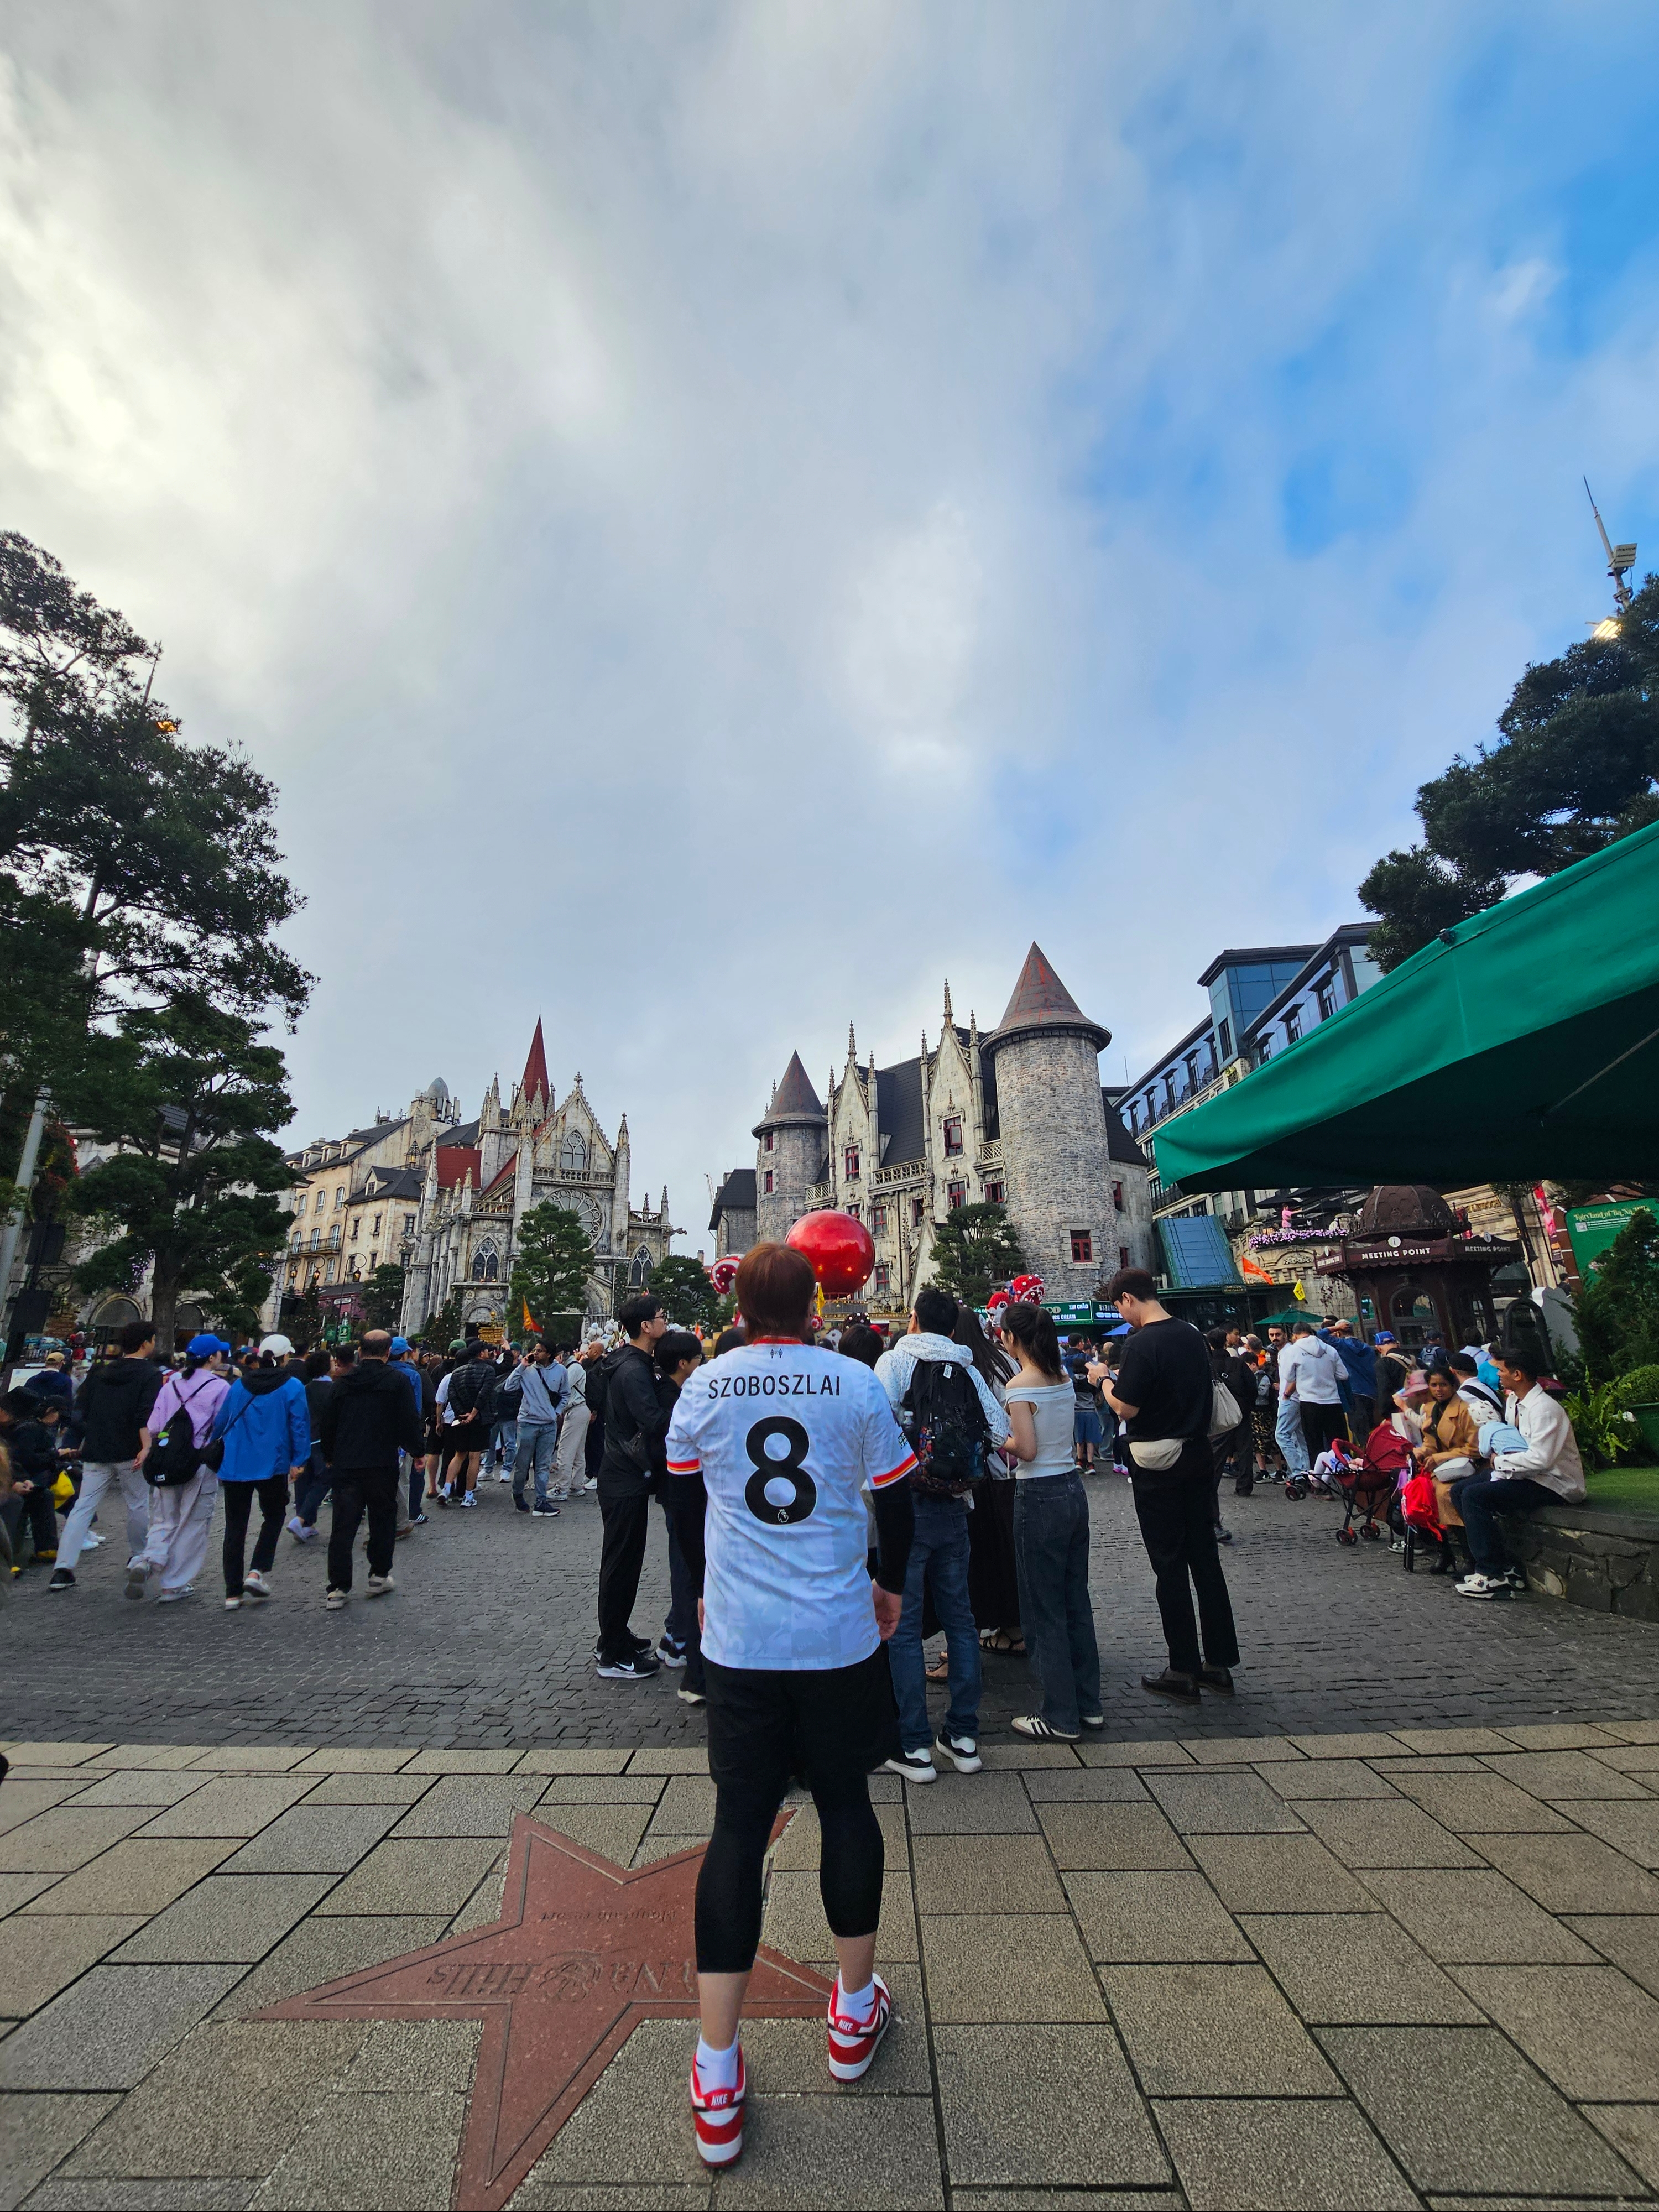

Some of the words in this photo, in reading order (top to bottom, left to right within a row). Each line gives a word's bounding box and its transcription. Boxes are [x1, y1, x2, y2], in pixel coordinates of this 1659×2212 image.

[1361, 1250, 1399, 1259] MEETING
[1402, 1248, 1430, 1256] POINT
[708, 1374, 840, 1399] SZOBOSZLAI
[744, 1415, 817, 1525] 8
[426, 1963, 541, 1995] Hills
[838, 2019, 853, 2032] NIKE
[711, 2093, 728, 2106] NIKE
